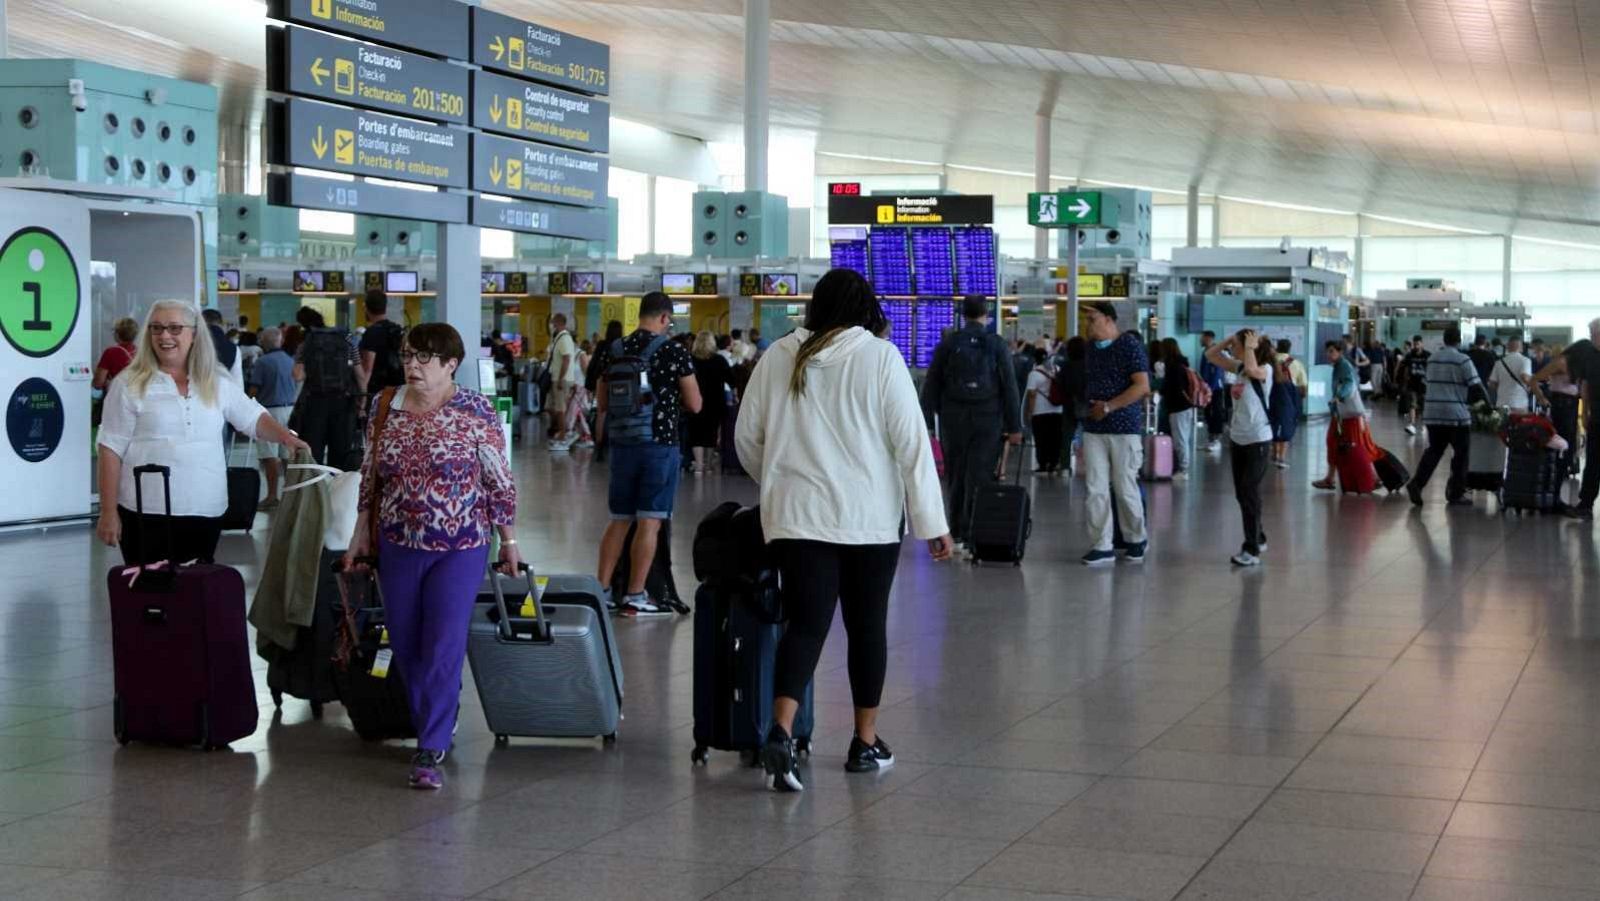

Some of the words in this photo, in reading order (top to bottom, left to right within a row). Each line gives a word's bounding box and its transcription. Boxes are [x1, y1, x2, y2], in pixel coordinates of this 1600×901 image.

[336, 7, 385, 31] Información
[527, 26, 561, 46] Facturació
[358, 48, 402, 70] Facturació
[527, 42, 552, 57] Check-in
[358, 66, 386, 82] Check-in
[527, 57, 564, 77] Facturación
[358, 82, 406, 104] Facturación
[525, 87, 549, 103] Control
[550, 93, 559, 106] de
[559, 97, 590, 114] seguretat
[525, 103, 546, 119] Security
[547, 109, 564, 121] control
[358, 117, 387, 134] Portes
[390, 123, 453, 147] d'embarcament
[525, 118, 549, 135] Control
[550, 124, 558, 136] de
[559, 128, 590, 142] seguridad
[358, 134, 389, 153] Boarding
[391, 141, 410, 155] gates
[358, 151, 392, 170] Puertas
[395, 157, 405, 172] de
[408, 161, 449, 178] embarque
[525, 147, 548, 163] Portes
[525, 163, 548, 180] Boarding
[897, 197, 937, 206] Informació
[897, 214, 942, 222] Información
